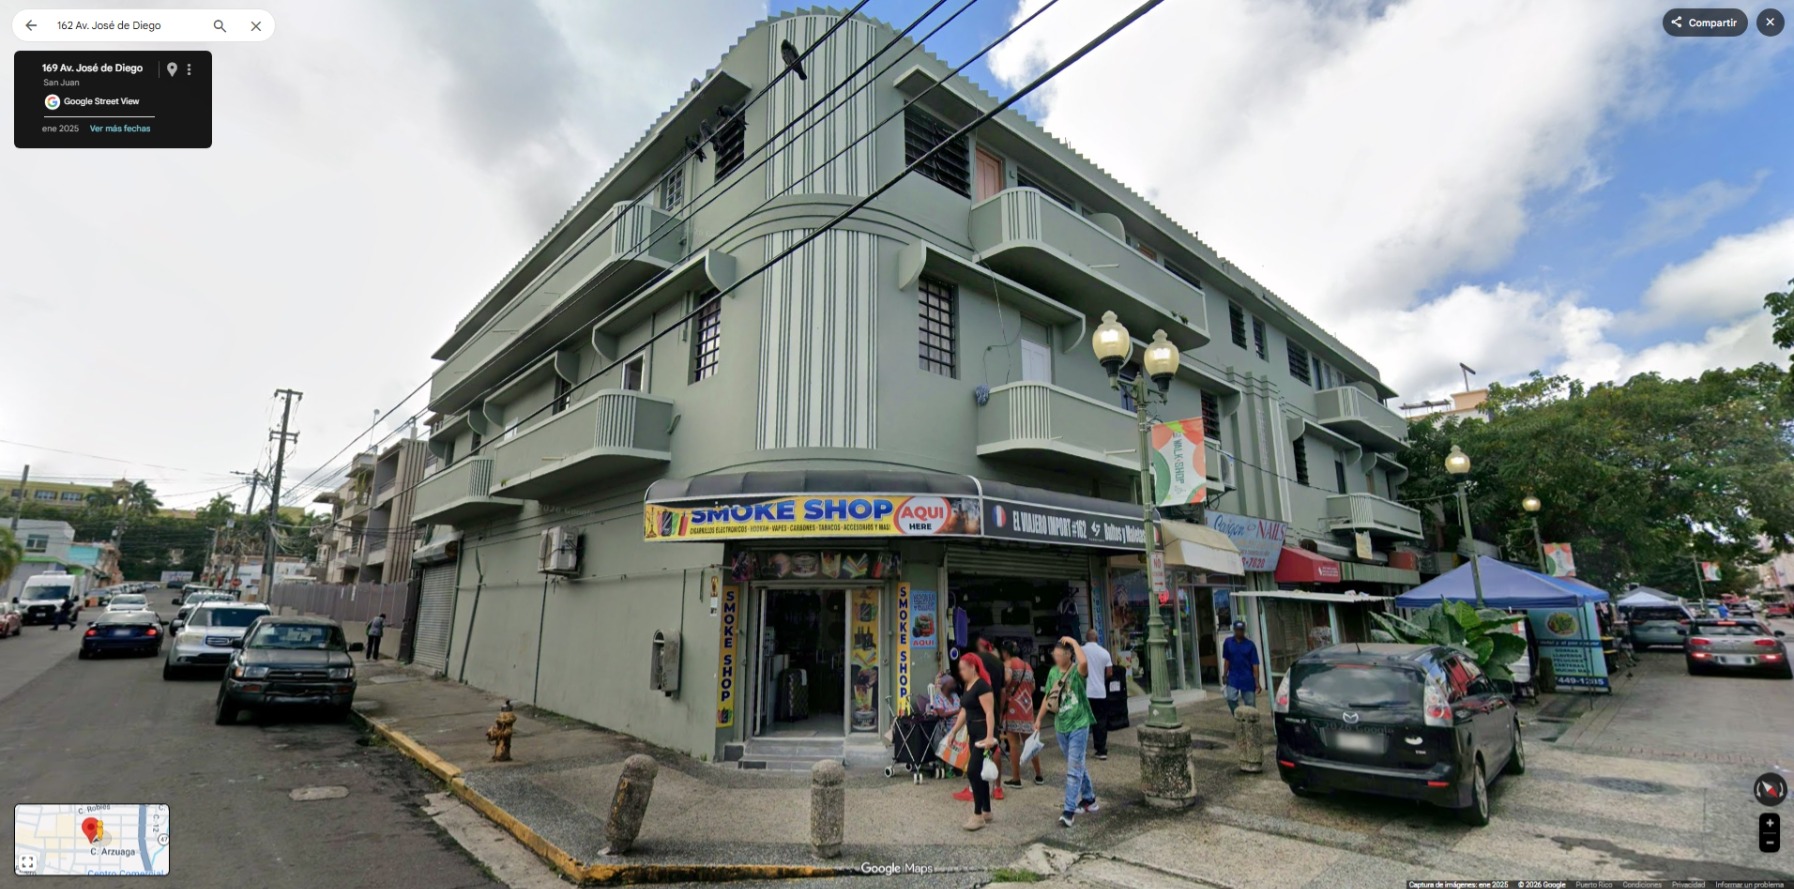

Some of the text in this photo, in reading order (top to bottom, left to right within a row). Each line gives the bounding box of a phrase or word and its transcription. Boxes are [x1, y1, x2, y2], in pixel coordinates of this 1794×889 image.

[690, 498, 894, 523] SMOKE SHOP
[901, 506, 944, 521] AQUI
[771, 524, 787, 532] VAPES
[818, 524, 841, 532] TABACOS
[909, 523, 932, 531] HERE
[1012, 511, 1087, 539] EL VIAJERO IMPORT #162
[1103, 522, 1122, 542] Bultos
[1122, 526, 1127, 544] y
[1255, 519, 1287, 542] NAILS
[723, 590, 736, 648] SMOKE
[898, 586, 908, 645] SMOKE
[720, 654, 733, 702] SHOP
[899, 650, 908, 698] SHOP
